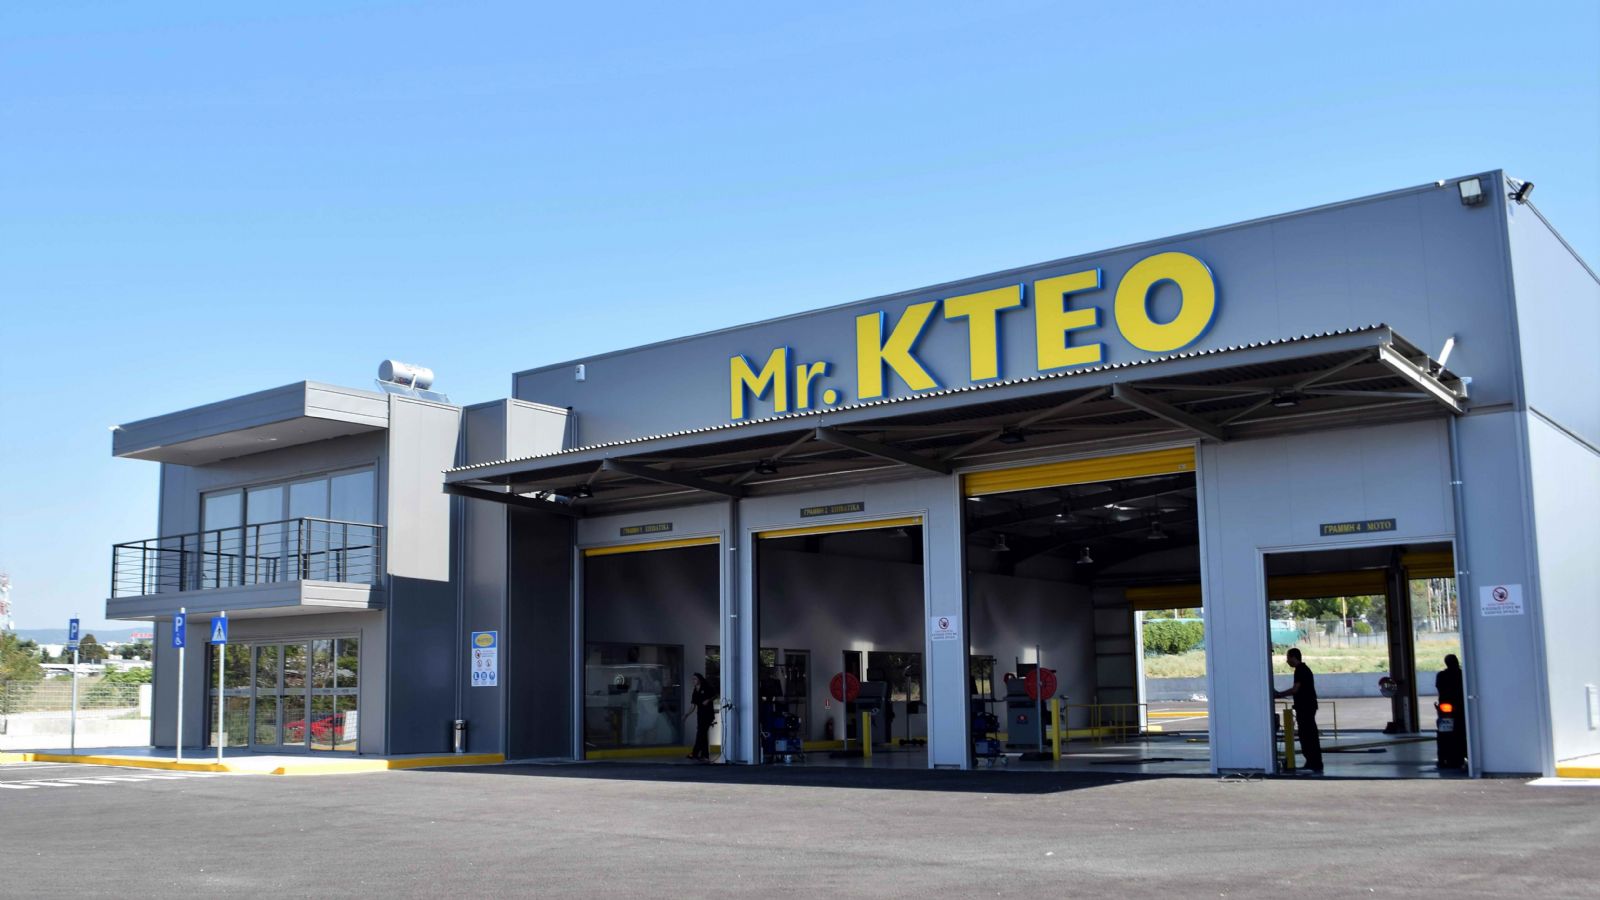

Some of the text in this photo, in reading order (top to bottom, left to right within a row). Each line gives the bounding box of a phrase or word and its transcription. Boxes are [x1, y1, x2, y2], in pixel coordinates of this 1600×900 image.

[730, 251, 1219, 421] Mr. KTEO
[1324, 523, 1355, 535] ΓΡΑΜΜΗ
[70, 623, 78, 638] P
[175, 616, 183, 632] P
